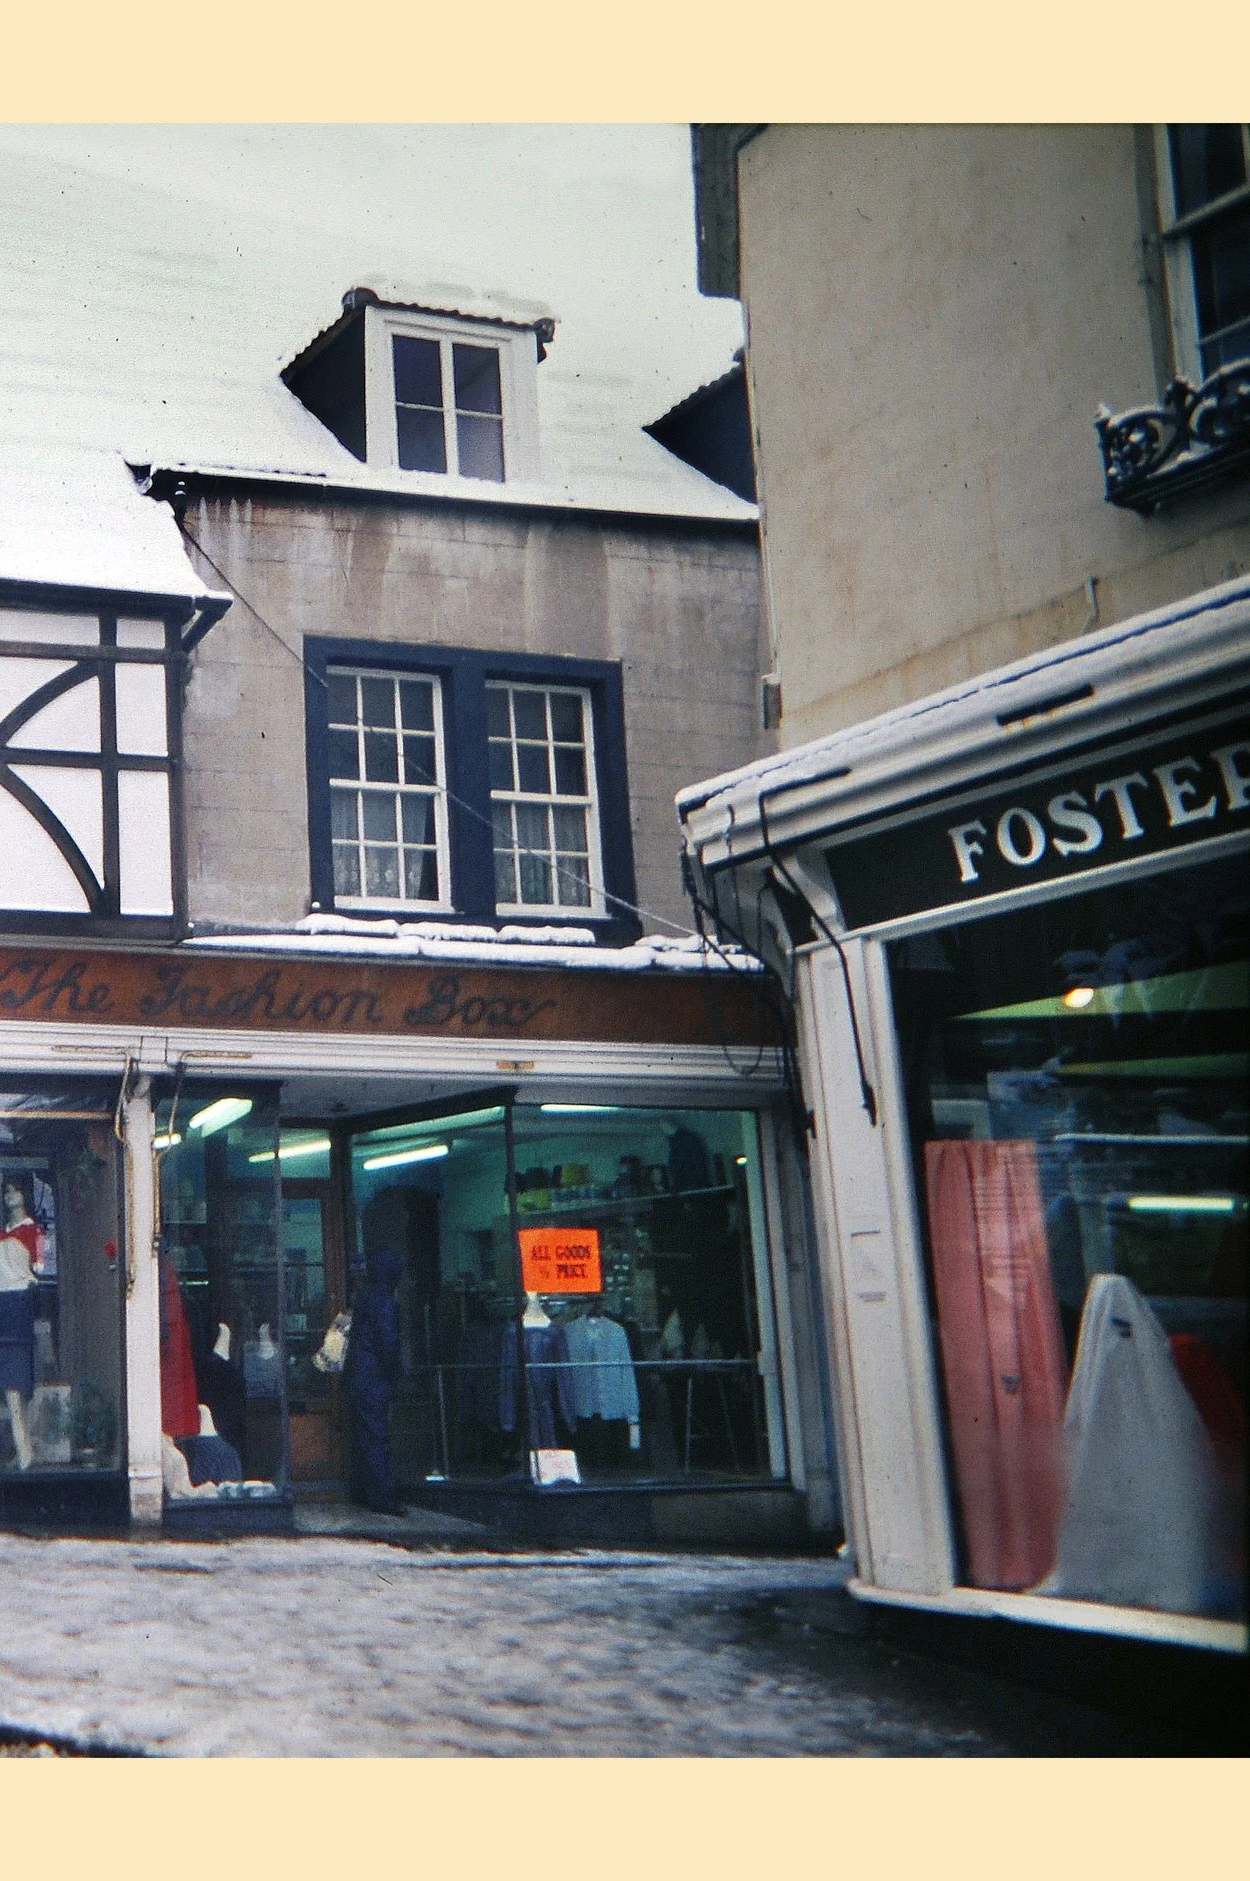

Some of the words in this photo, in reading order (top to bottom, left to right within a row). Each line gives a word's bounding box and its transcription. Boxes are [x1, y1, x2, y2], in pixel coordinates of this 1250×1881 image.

[138, 962, 384, 1022] Fashion
[405, 975, 558, 1027] Box
[531, 1244, 551, 1261] ALL
[555, 1244, 592, 1261] GOODS
